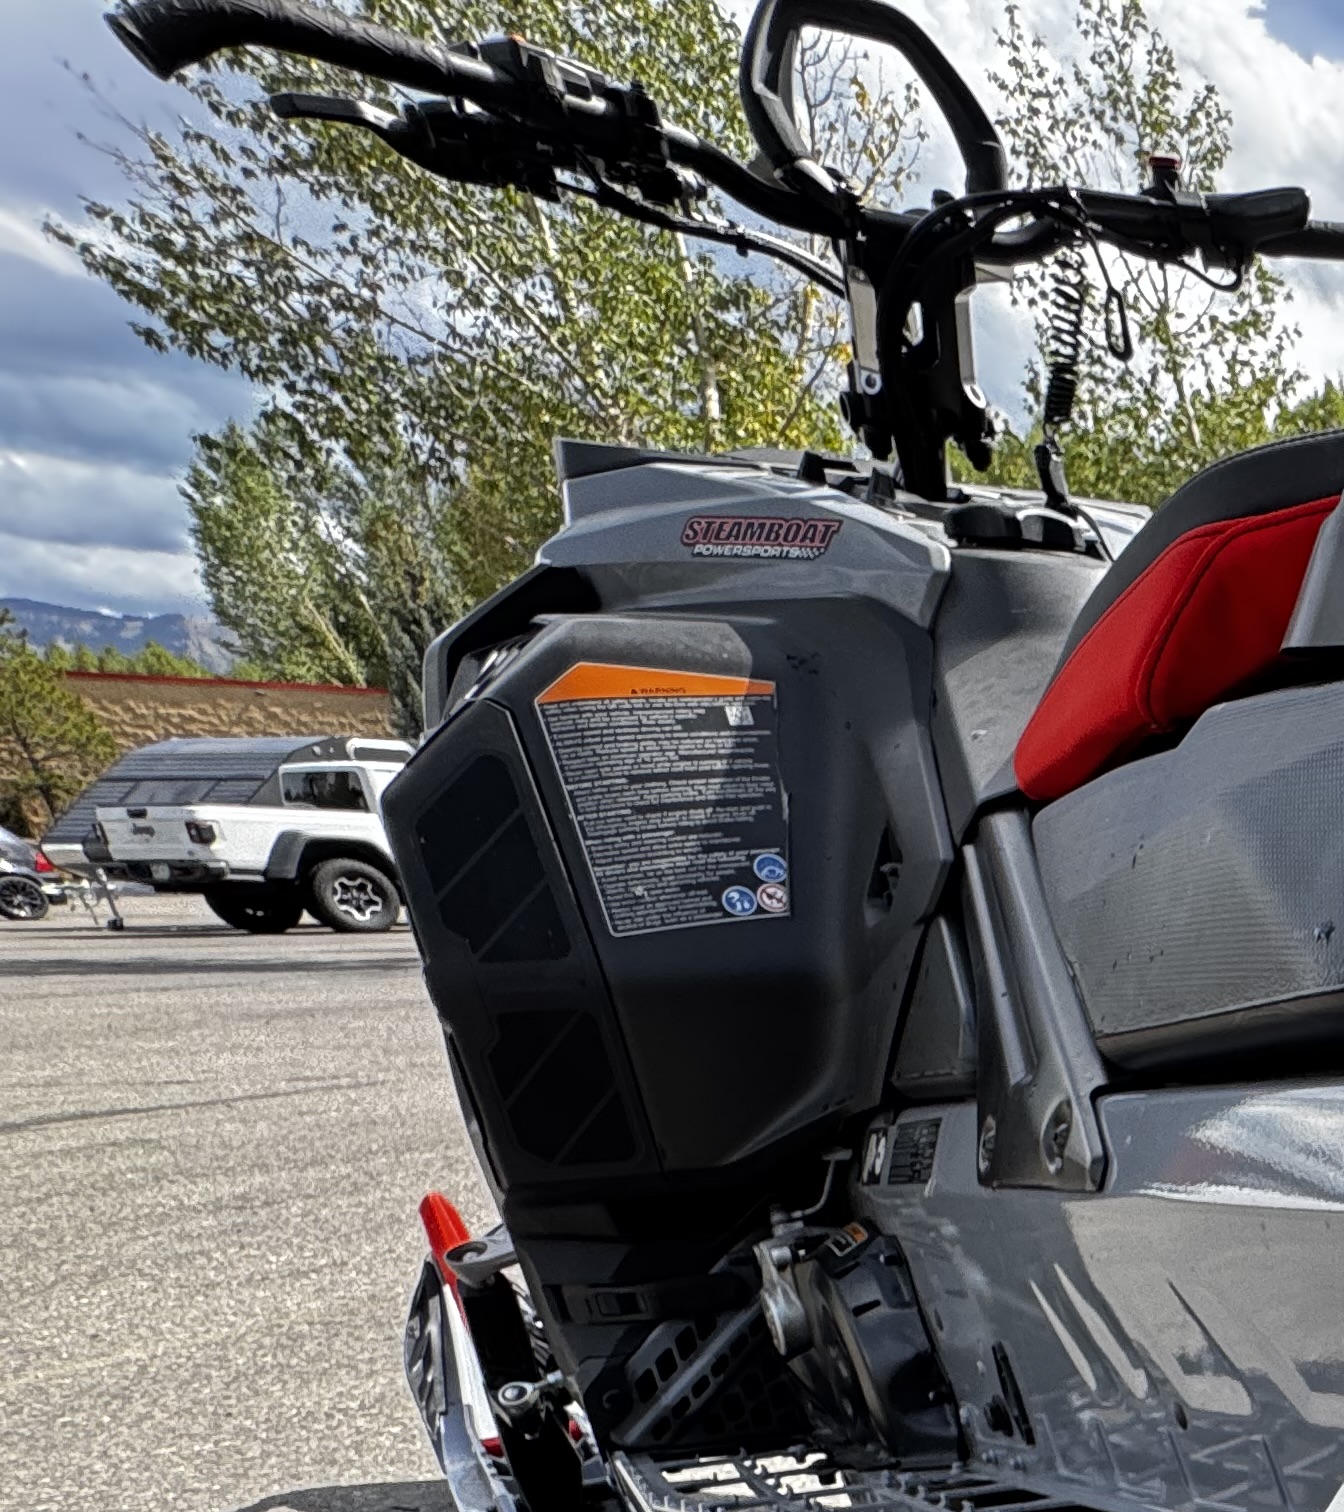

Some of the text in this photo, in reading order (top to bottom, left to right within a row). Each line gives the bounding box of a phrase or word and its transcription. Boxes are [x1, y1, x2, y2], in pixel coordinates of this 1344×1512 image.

[683, 518, 837, 545] STEAMBOAT
[693, 543, 802, 559] POWERSPORTS
[639, 686, 687, 695] WARNING
